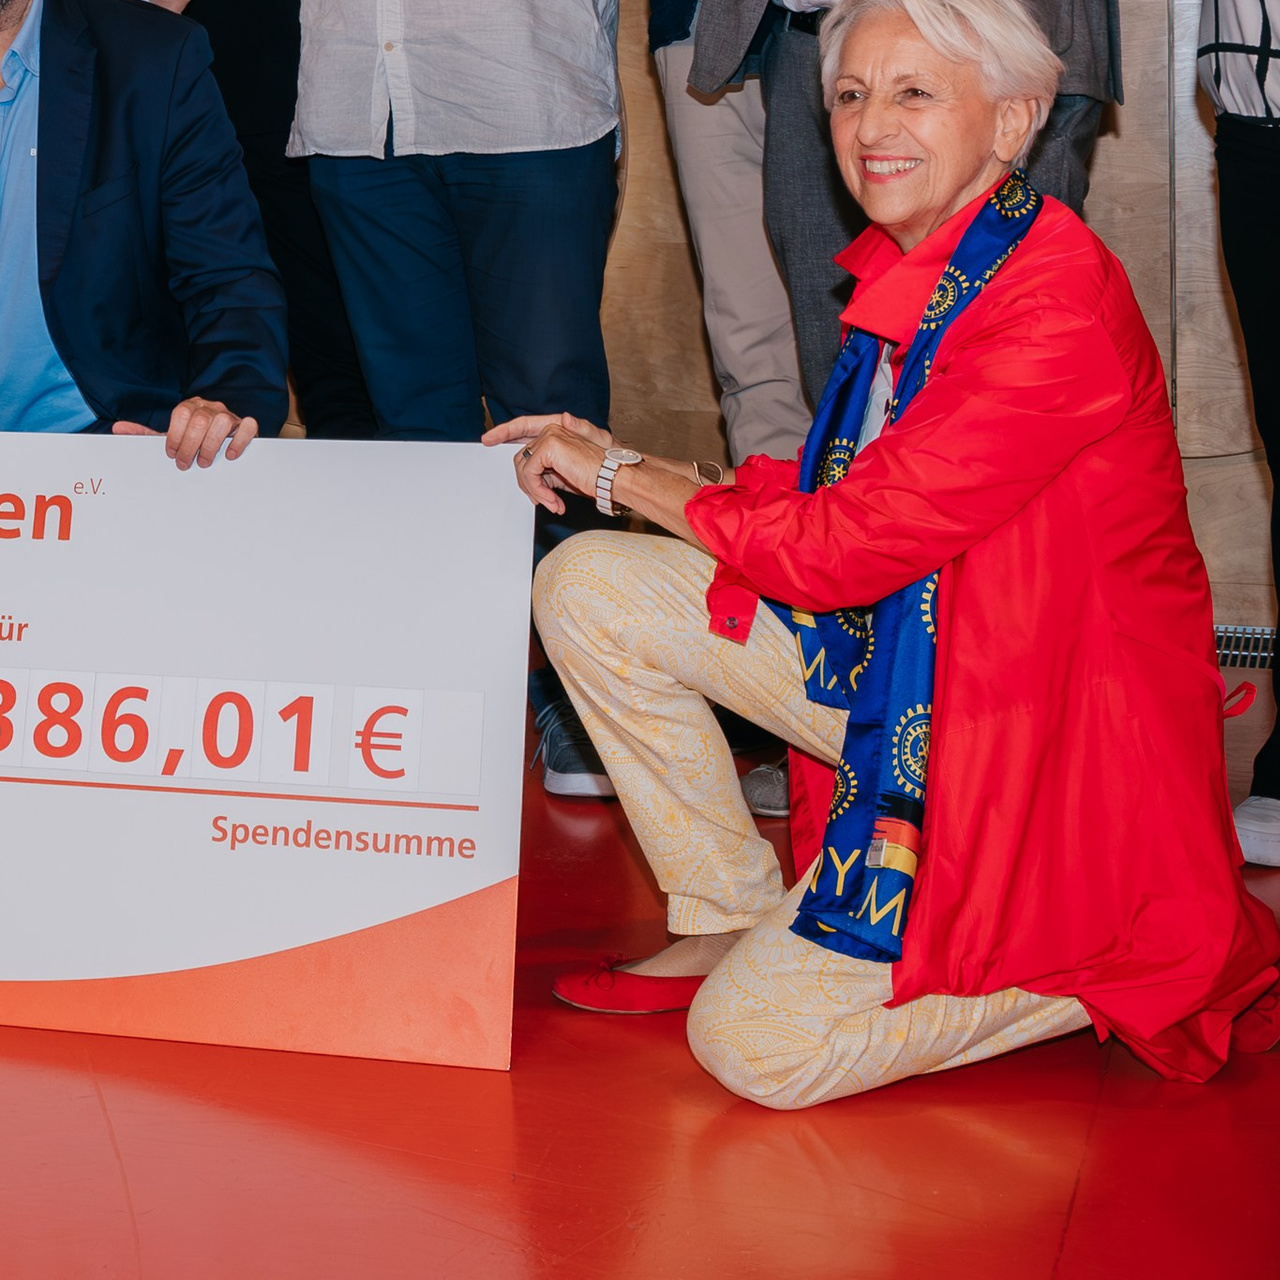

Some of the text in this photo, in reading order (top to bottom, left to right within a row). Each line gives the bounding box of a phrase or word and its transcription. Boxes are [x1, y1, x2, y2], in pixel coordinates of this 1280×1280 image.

[73, 477, 107, 496] e.V.
[354, 705, 409, 780] €
[211, 815, 477, 860] Spendensumme
